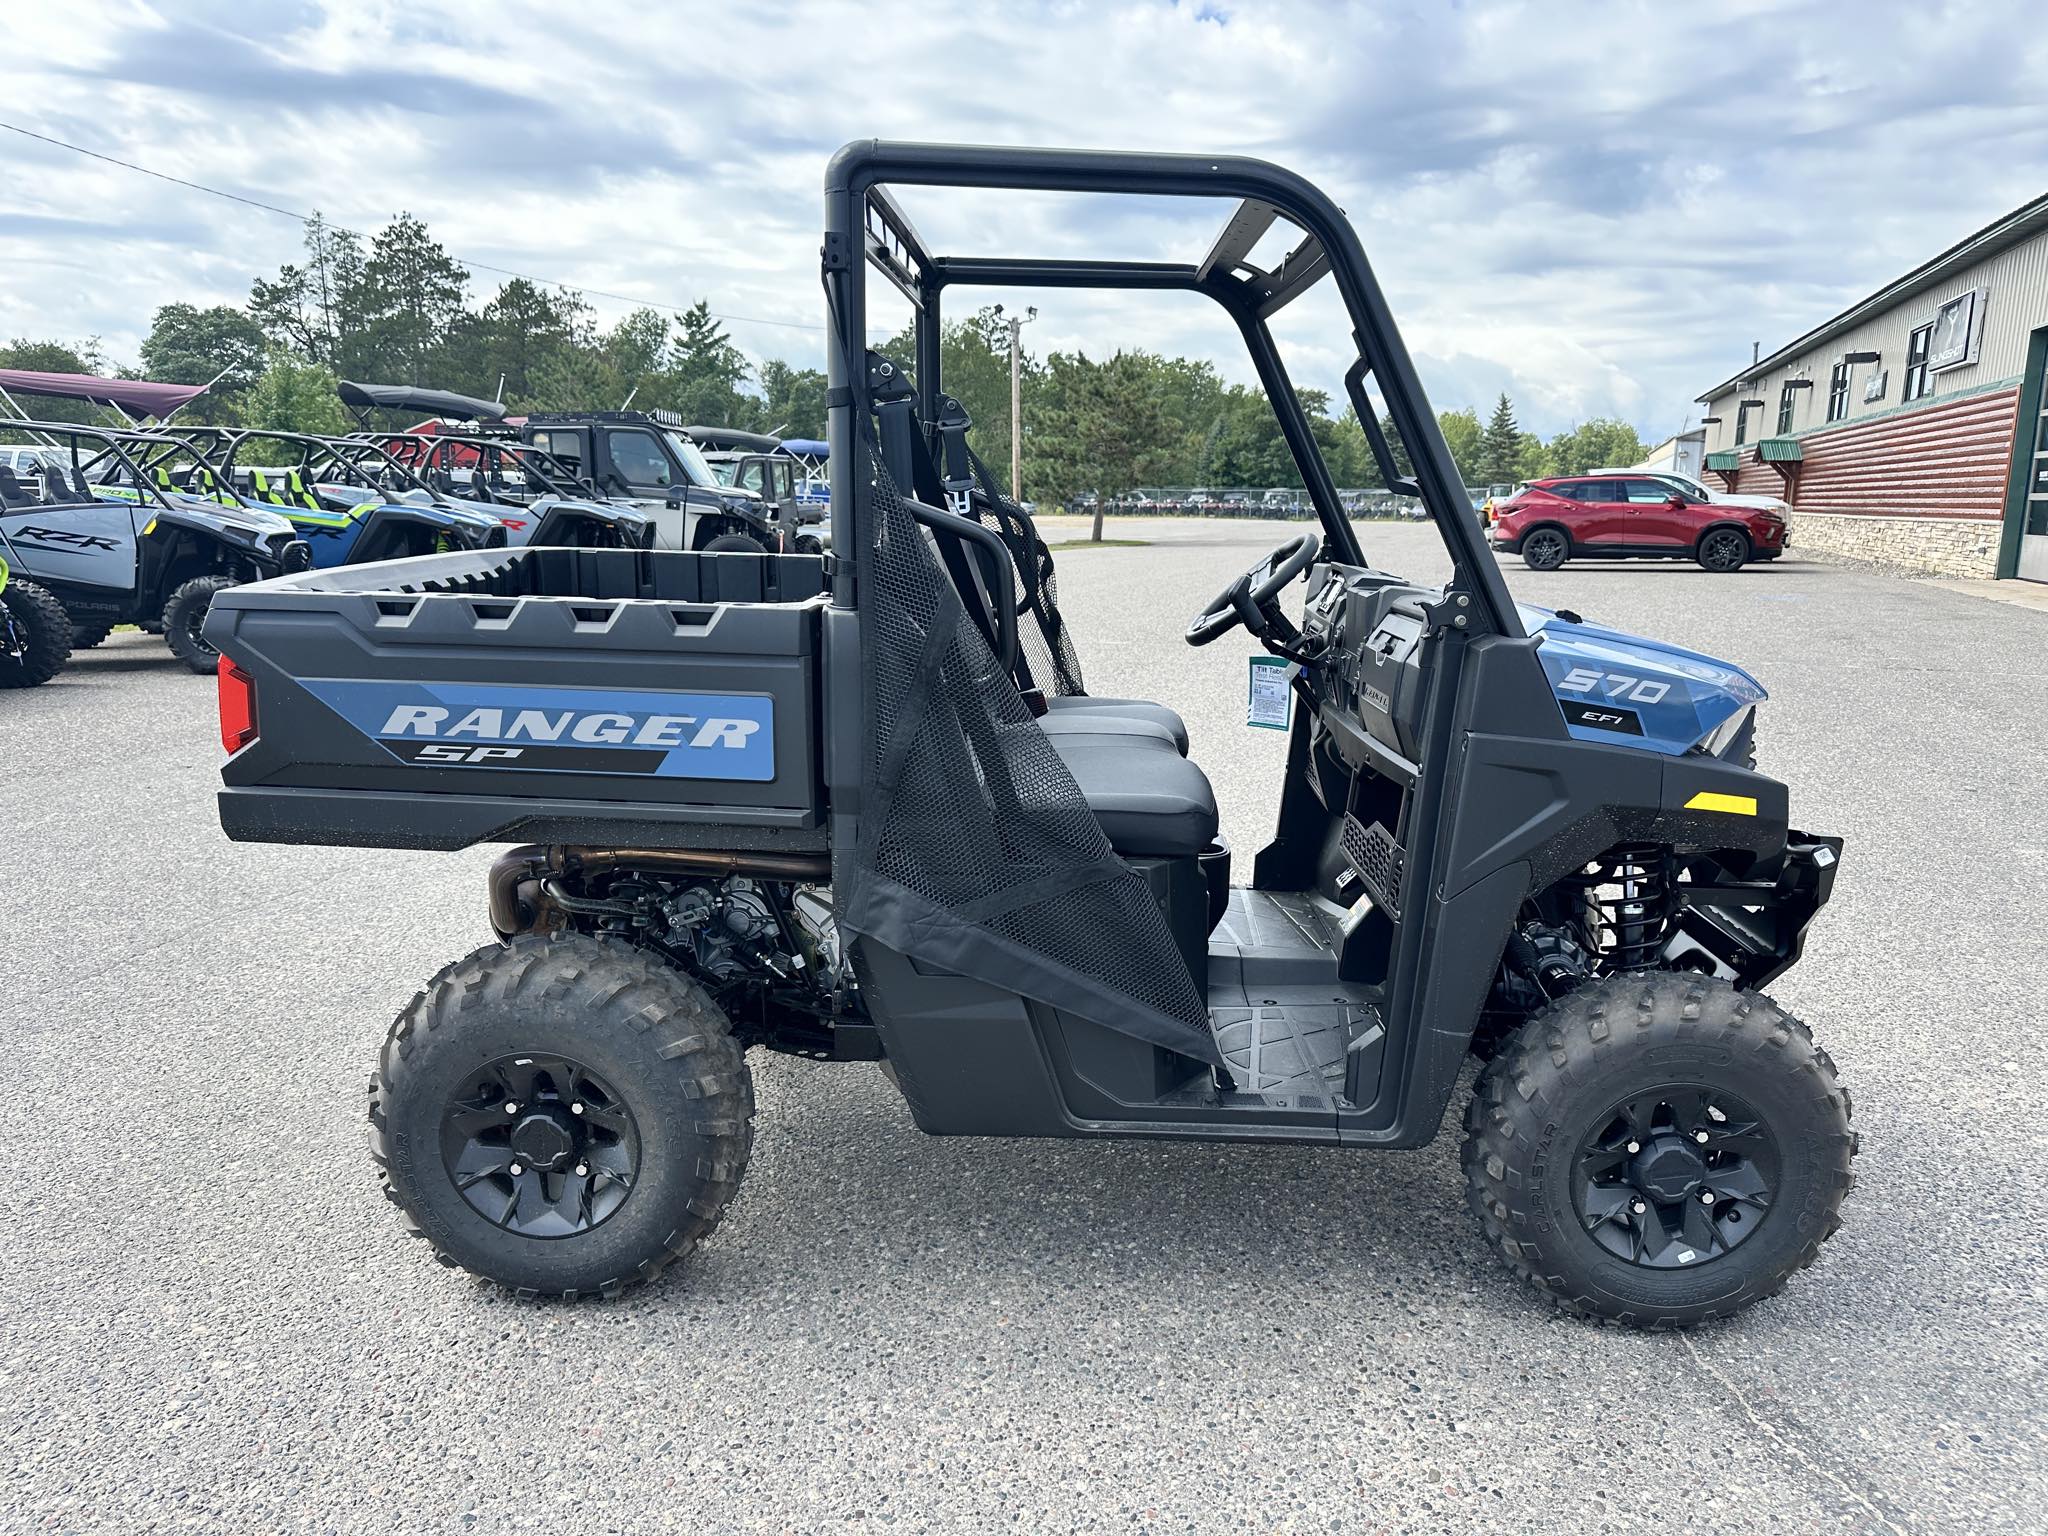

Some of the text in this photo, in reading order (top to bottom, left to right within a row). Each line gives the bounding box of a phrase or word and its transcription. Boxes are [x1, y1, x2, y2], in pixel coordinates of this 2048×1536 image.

[13, 526, 122, 552] RZR
[66, 600, 121, 612] POLARIS
[1557, 667, 1671, 704] 570
[380, 704, 760, 750] RANGER
[1581, 711, 1624, 724] EFI
[413, 744, 524, 763] SP
[1529, 1120, 1559, 1234] CARLSTAR
